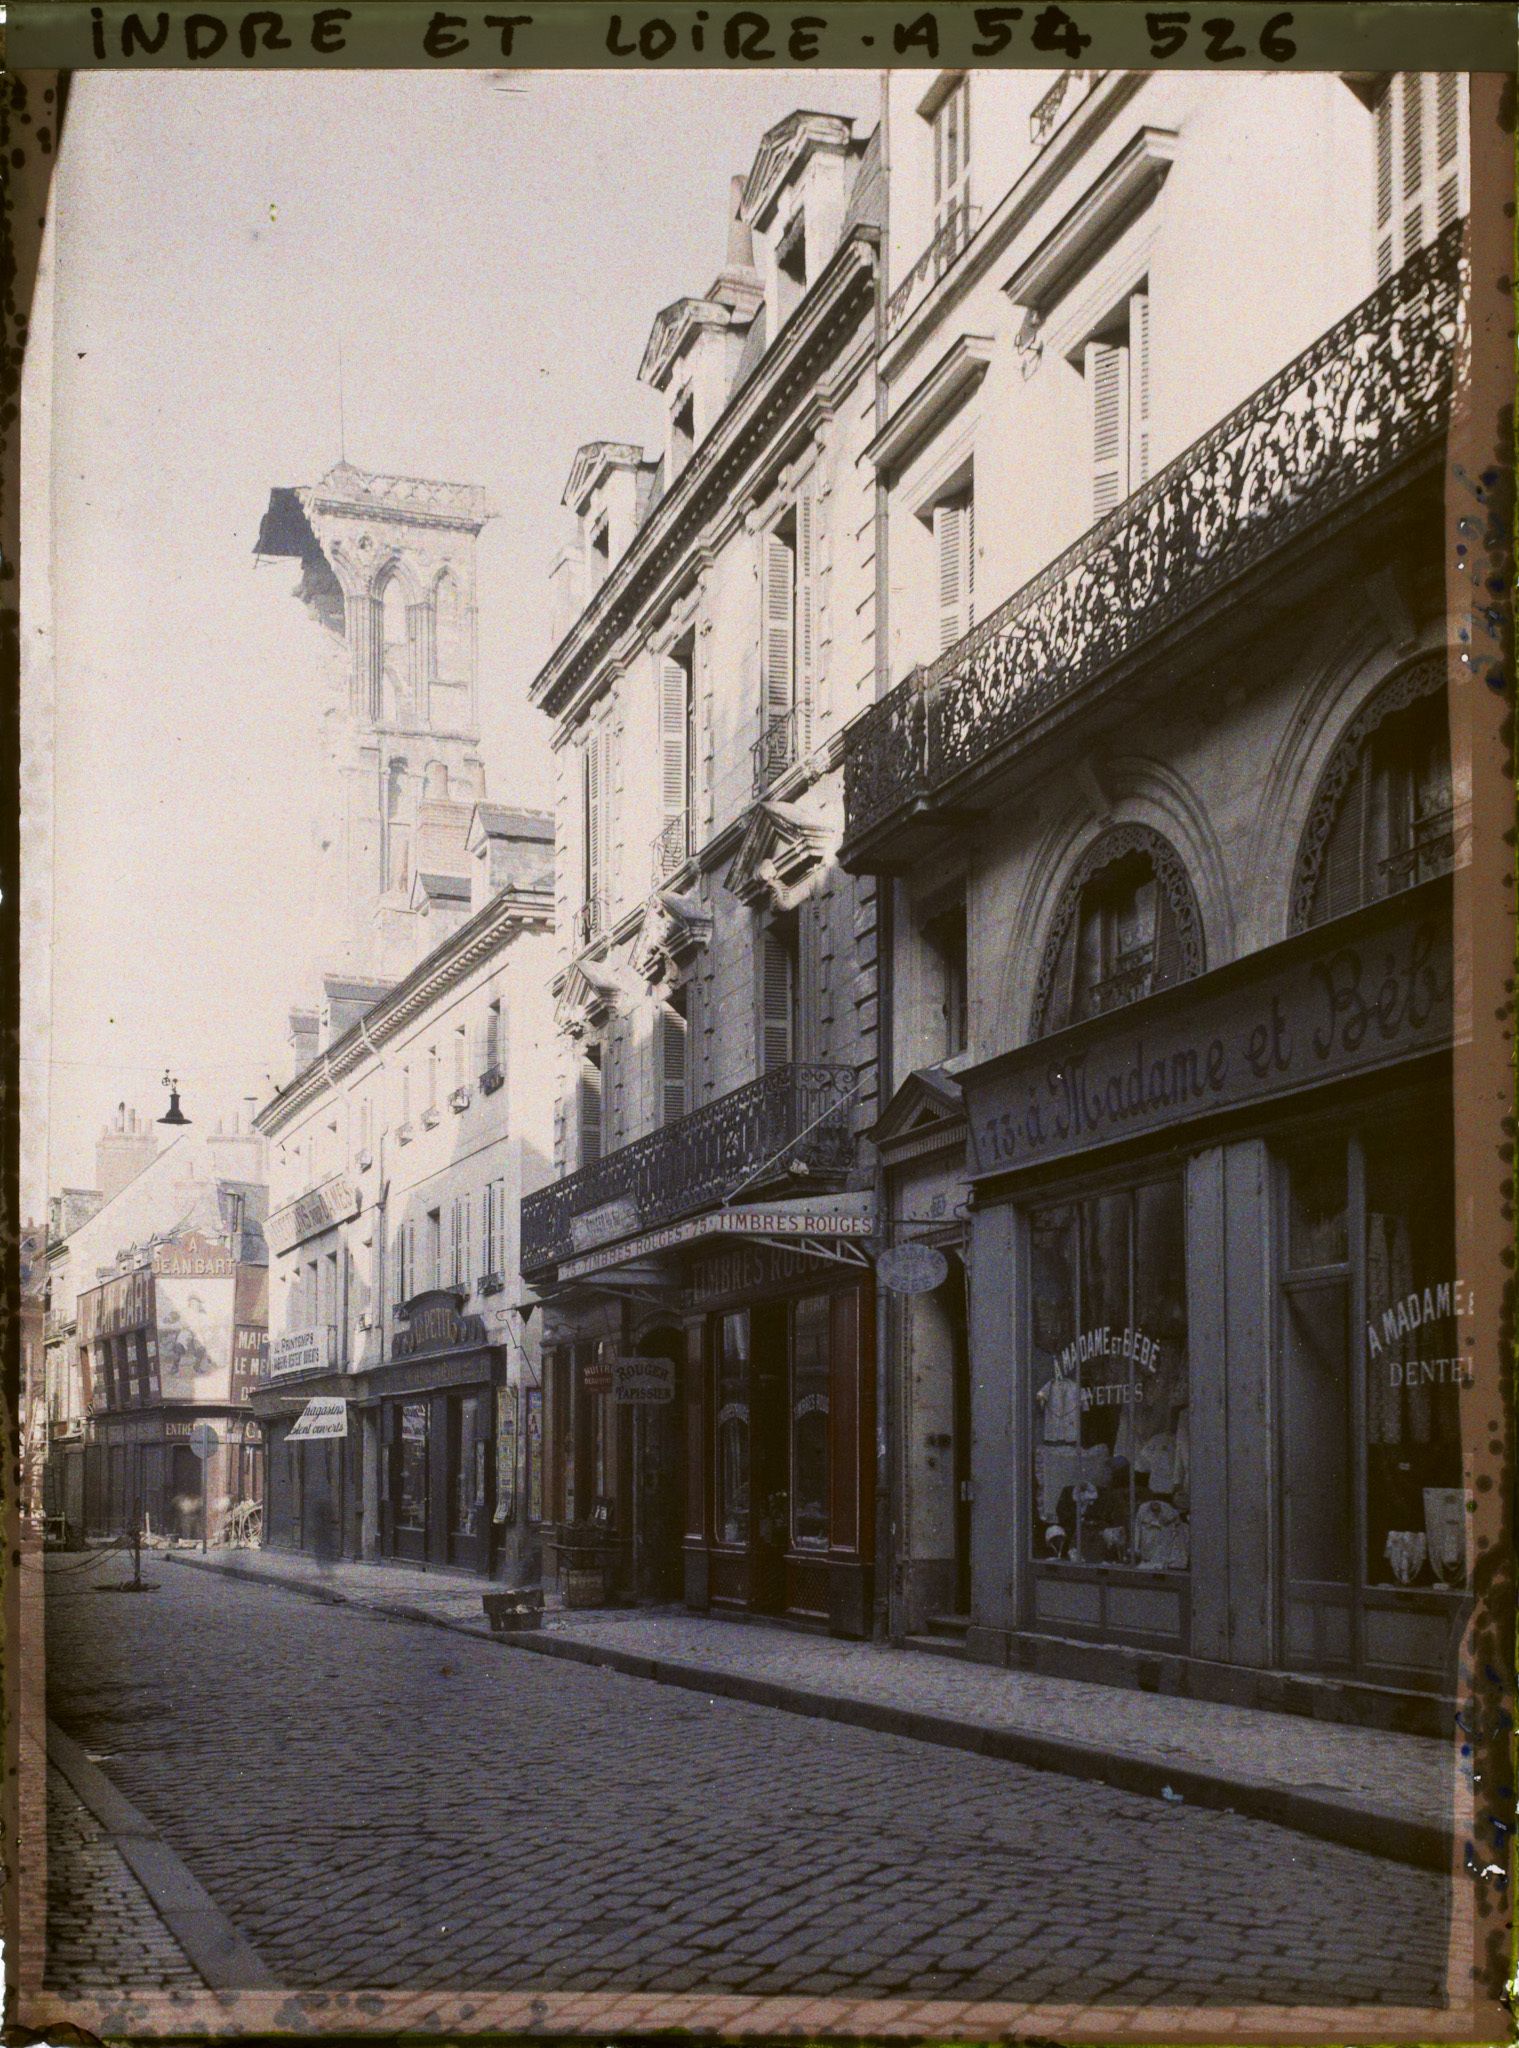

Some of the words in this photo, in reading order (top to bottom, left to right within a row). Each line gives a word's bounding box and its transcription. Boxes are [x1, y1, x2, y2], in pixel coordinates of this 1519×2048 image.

[1046, 1039, 1229, 1139] Madame
[1242, 1002, 1293, 1079] et
[719, 1213, 799, 1233] TIMBRES
[804, 1216, 873, 1234] ROUGES
[152, 1258, 192, 1275] JEAN
[192, 1259, 236, 1275] BART
[583, 1246, 633, 1272] TIMBRES
[636, 1228, 682, 1256] ROUGES
[692, 1246, 766, 1302] TIMBRES
[1382, 1280, 1465, 1345] MADAME
[1061, 1326, 1111, 1377] MADAME
[1122, 1326, 1161, 1373] BÉBÉ
